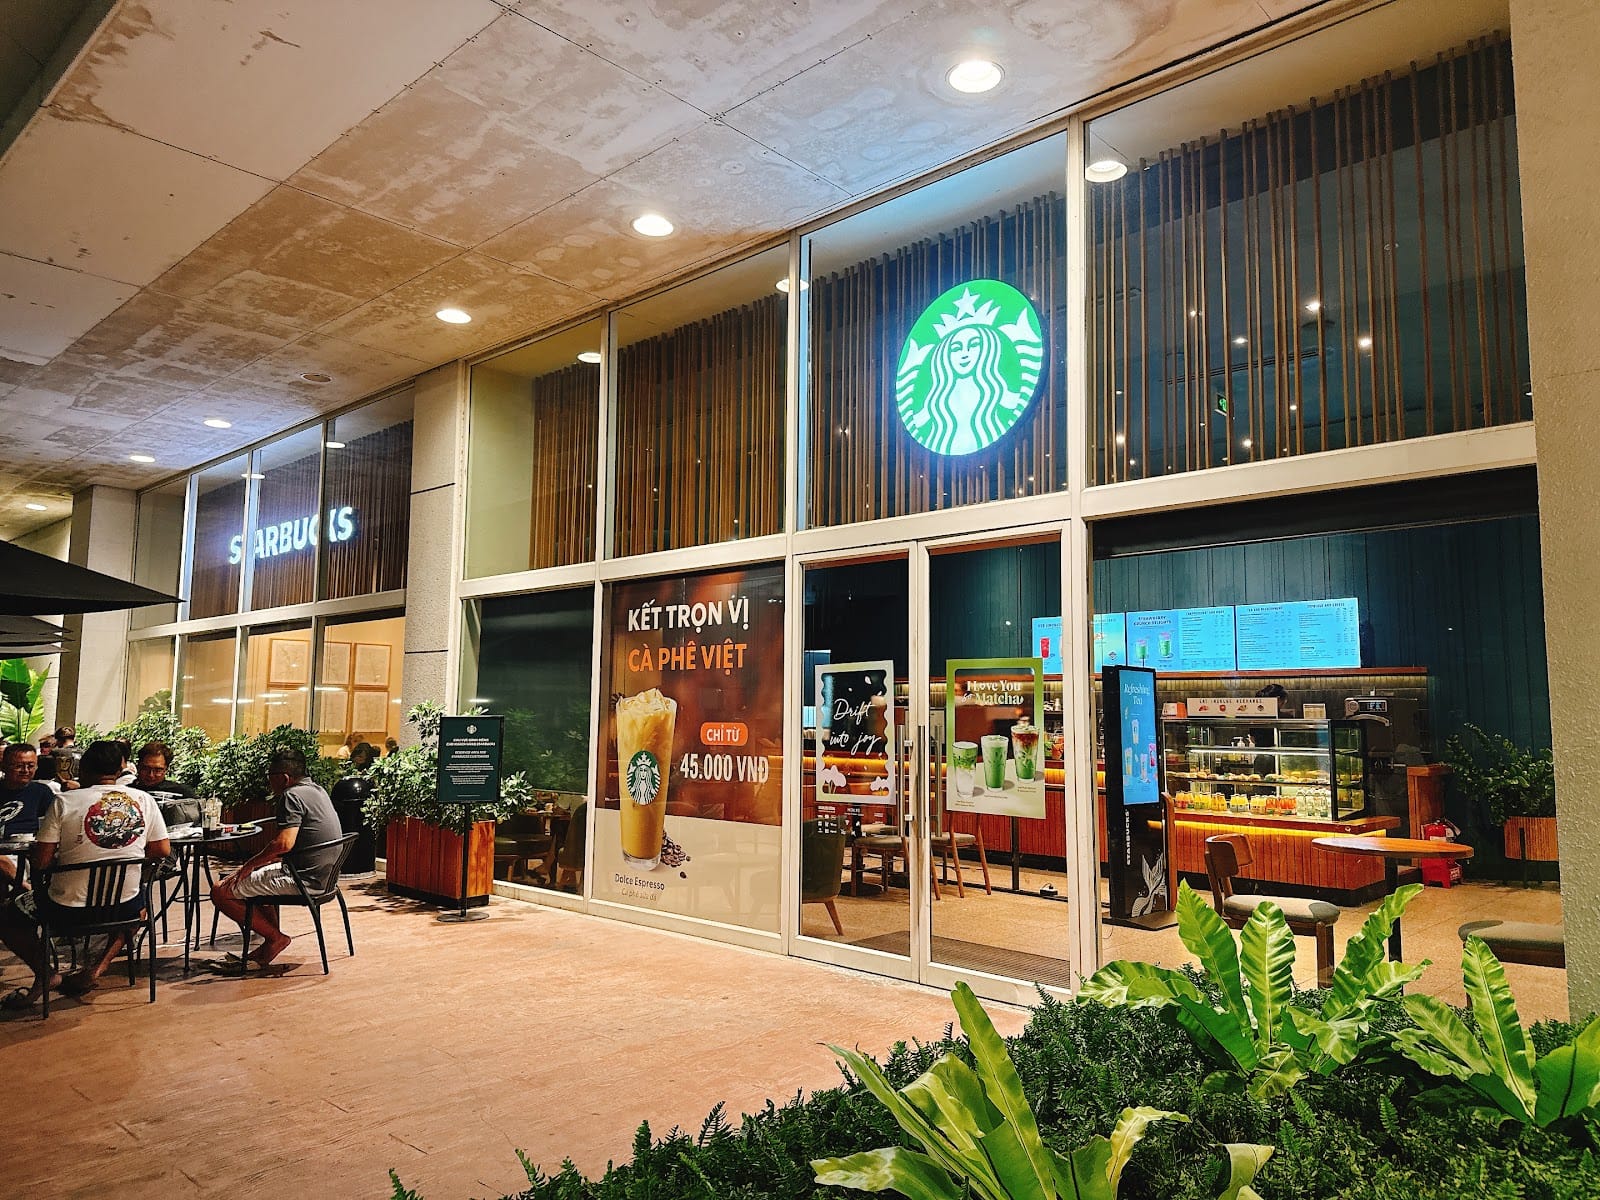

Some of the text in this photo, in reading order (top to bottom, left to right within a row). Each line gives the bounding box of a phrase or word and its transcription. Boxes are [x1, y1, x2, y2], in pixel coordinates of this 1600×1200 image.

[229, 506, 353, 565] SARBUCKS
[628, 598, 749, 634] KẾT TRỌN VỊ
[628, 637, 747, 676] CÀ PHÊ VIỆT
[967, 679, 1022, 692] I Love You
[833, 698, 877, 725] Drift
[706, 724, 740, 742] CHỈ TỪ
[829, 730, 882, 756] into joy
[680, 753, 769, 784] 45.000 VNĐ
[615, 873, 665, 891] Dolce Espresso
